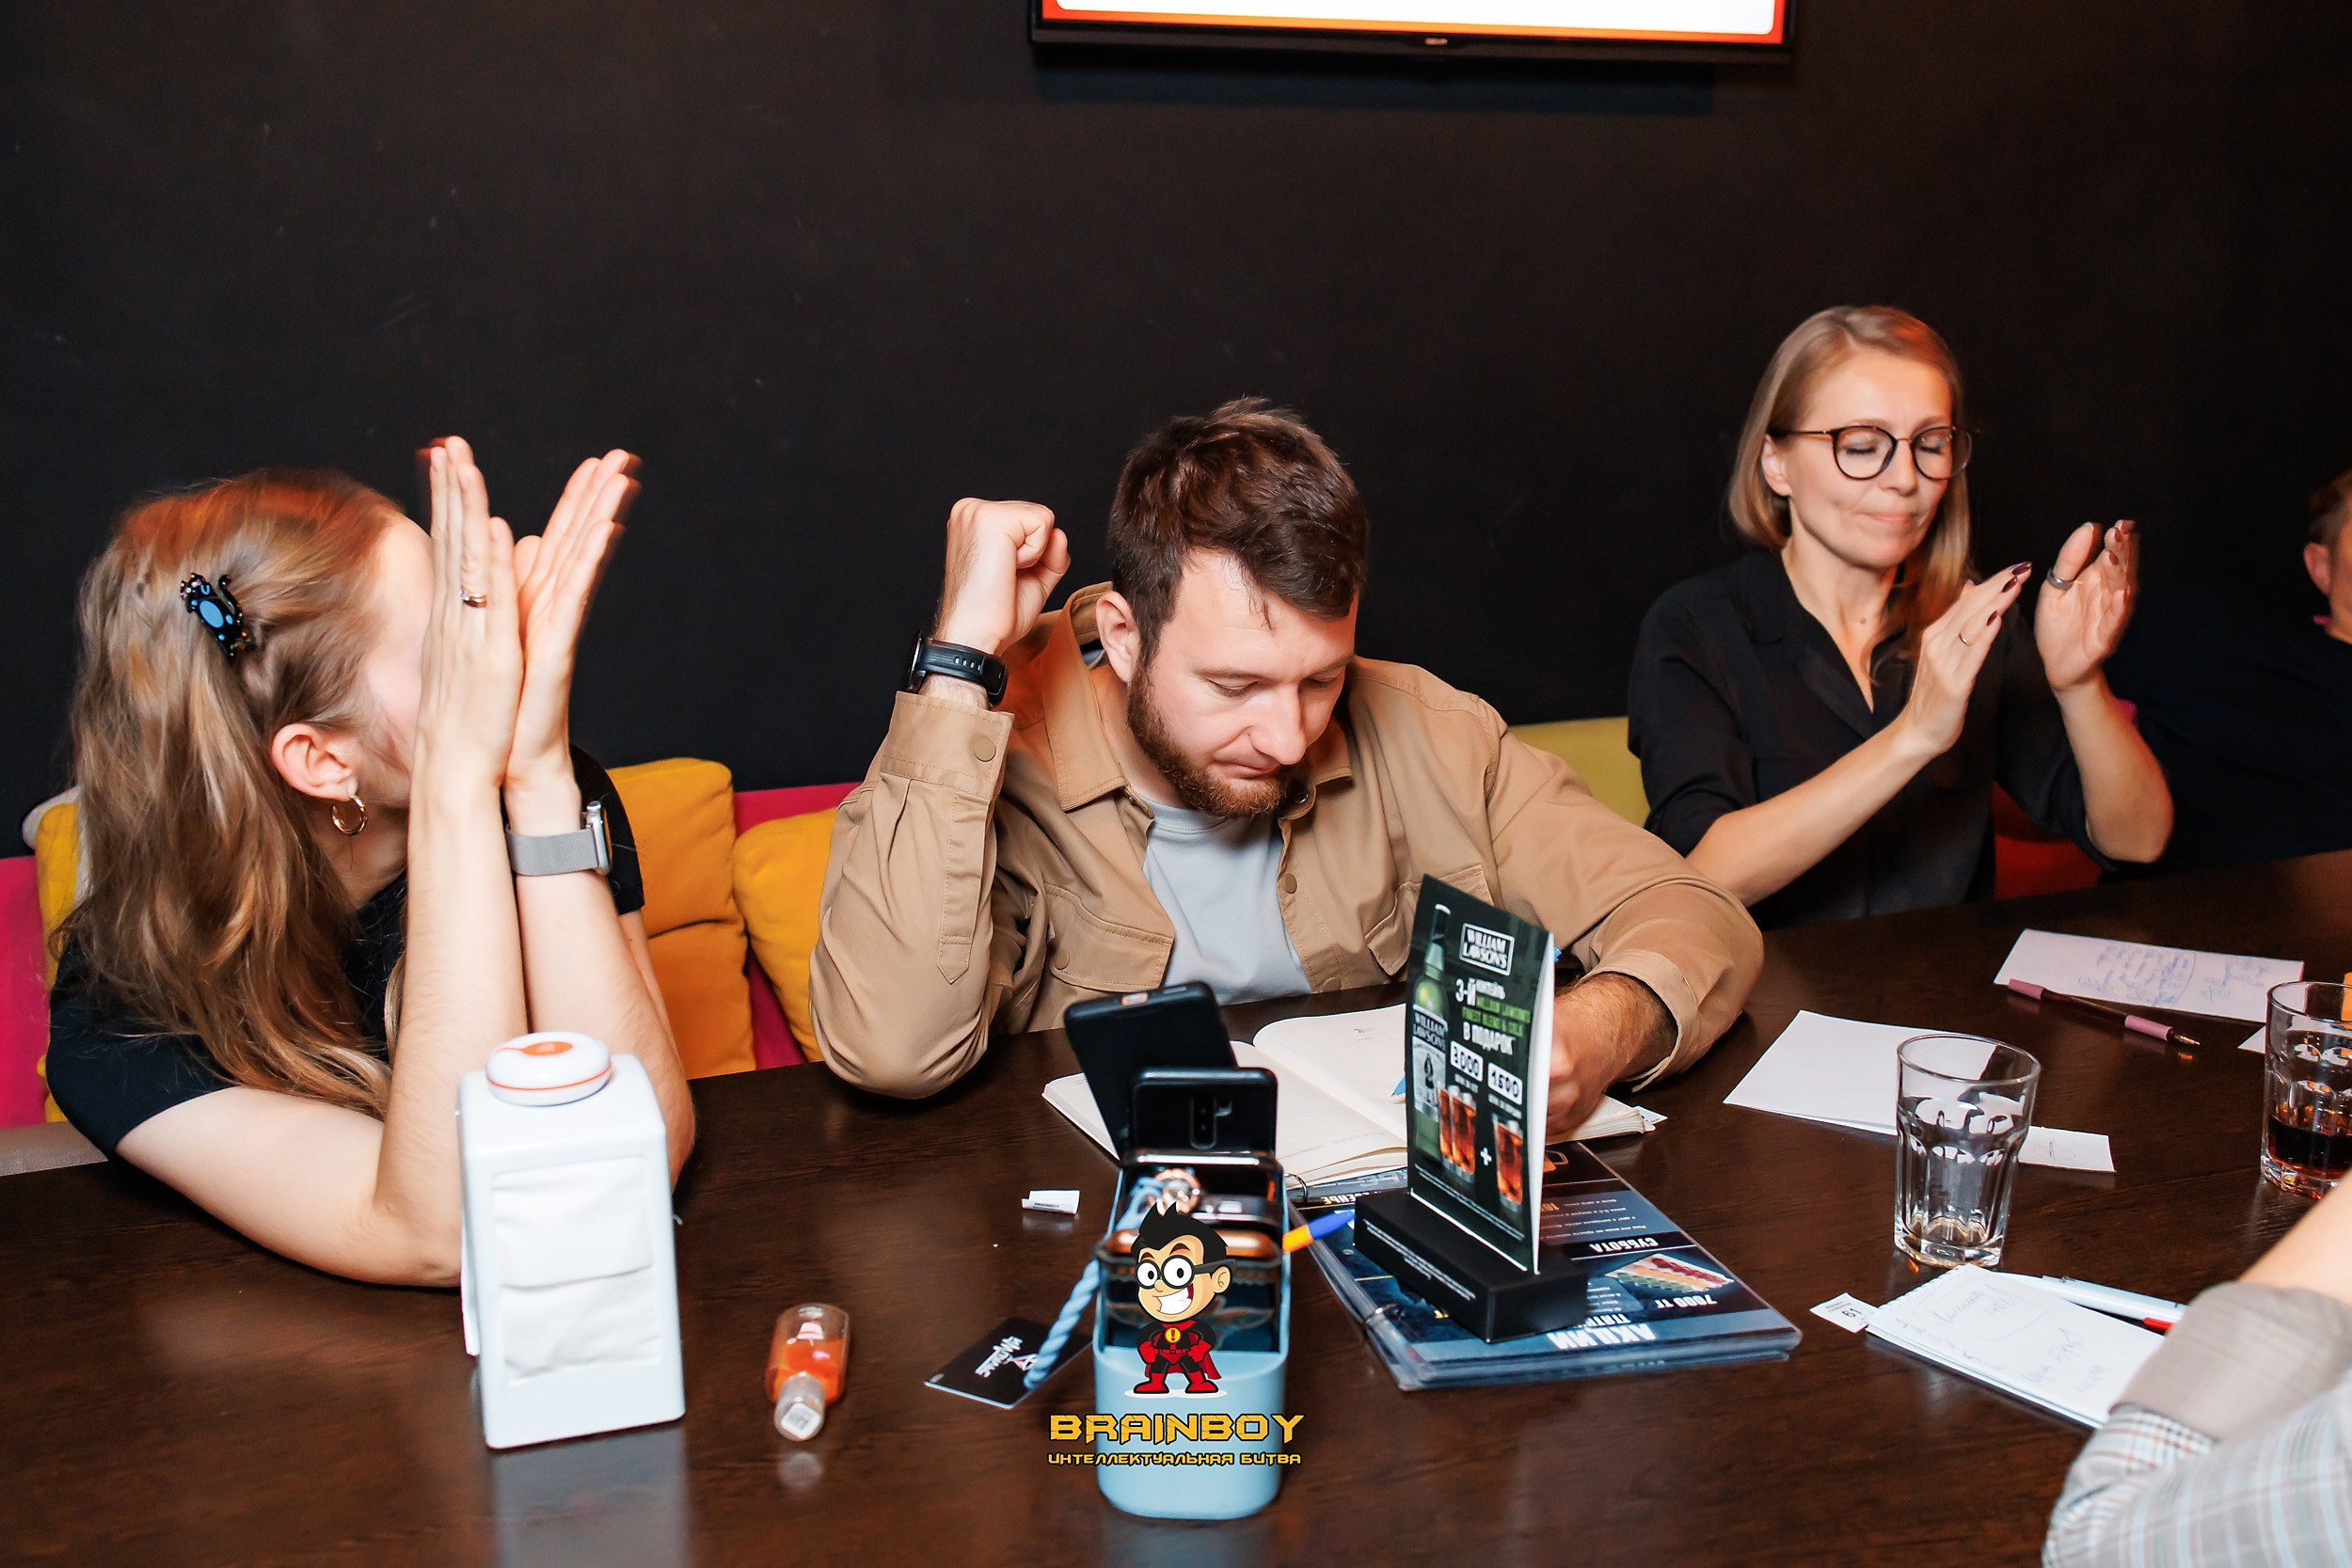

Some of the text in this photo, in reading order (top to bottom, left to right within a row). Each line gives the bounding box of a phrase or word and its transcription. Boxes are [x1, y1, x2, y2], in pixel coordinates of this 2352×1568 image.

[1467, 928, 1506, 953] WILLIAM
[1492, 1070, 1519, 1098] 1500
[1589, 1237, 1659, 1253] СУББОТА
[1673, 1293, 1718, 1308] 7000
[1546, 1323, 1656, 1350] АКЦИИ
